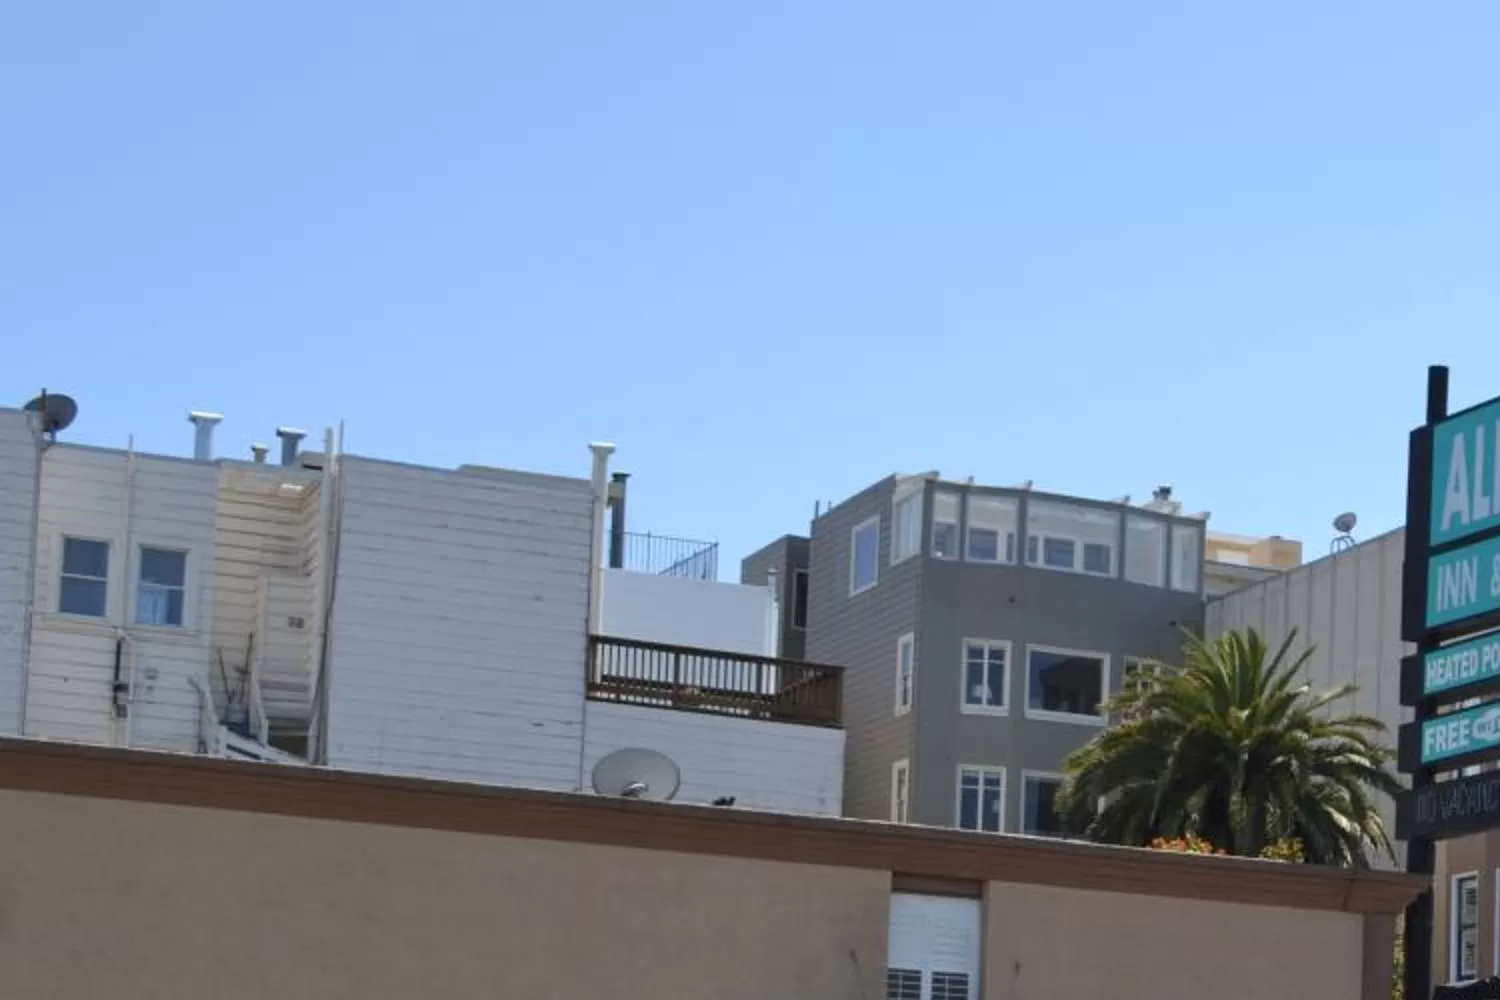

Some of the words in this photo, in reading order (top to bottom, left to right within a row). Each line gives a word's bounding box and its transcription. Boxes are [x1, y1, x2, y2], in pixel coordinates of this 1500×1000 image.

[1436, 557, 1477, 612] INN
[1426, 649, 1478, 685] HEATED
[1425, 718, 1470, 756] FREE
